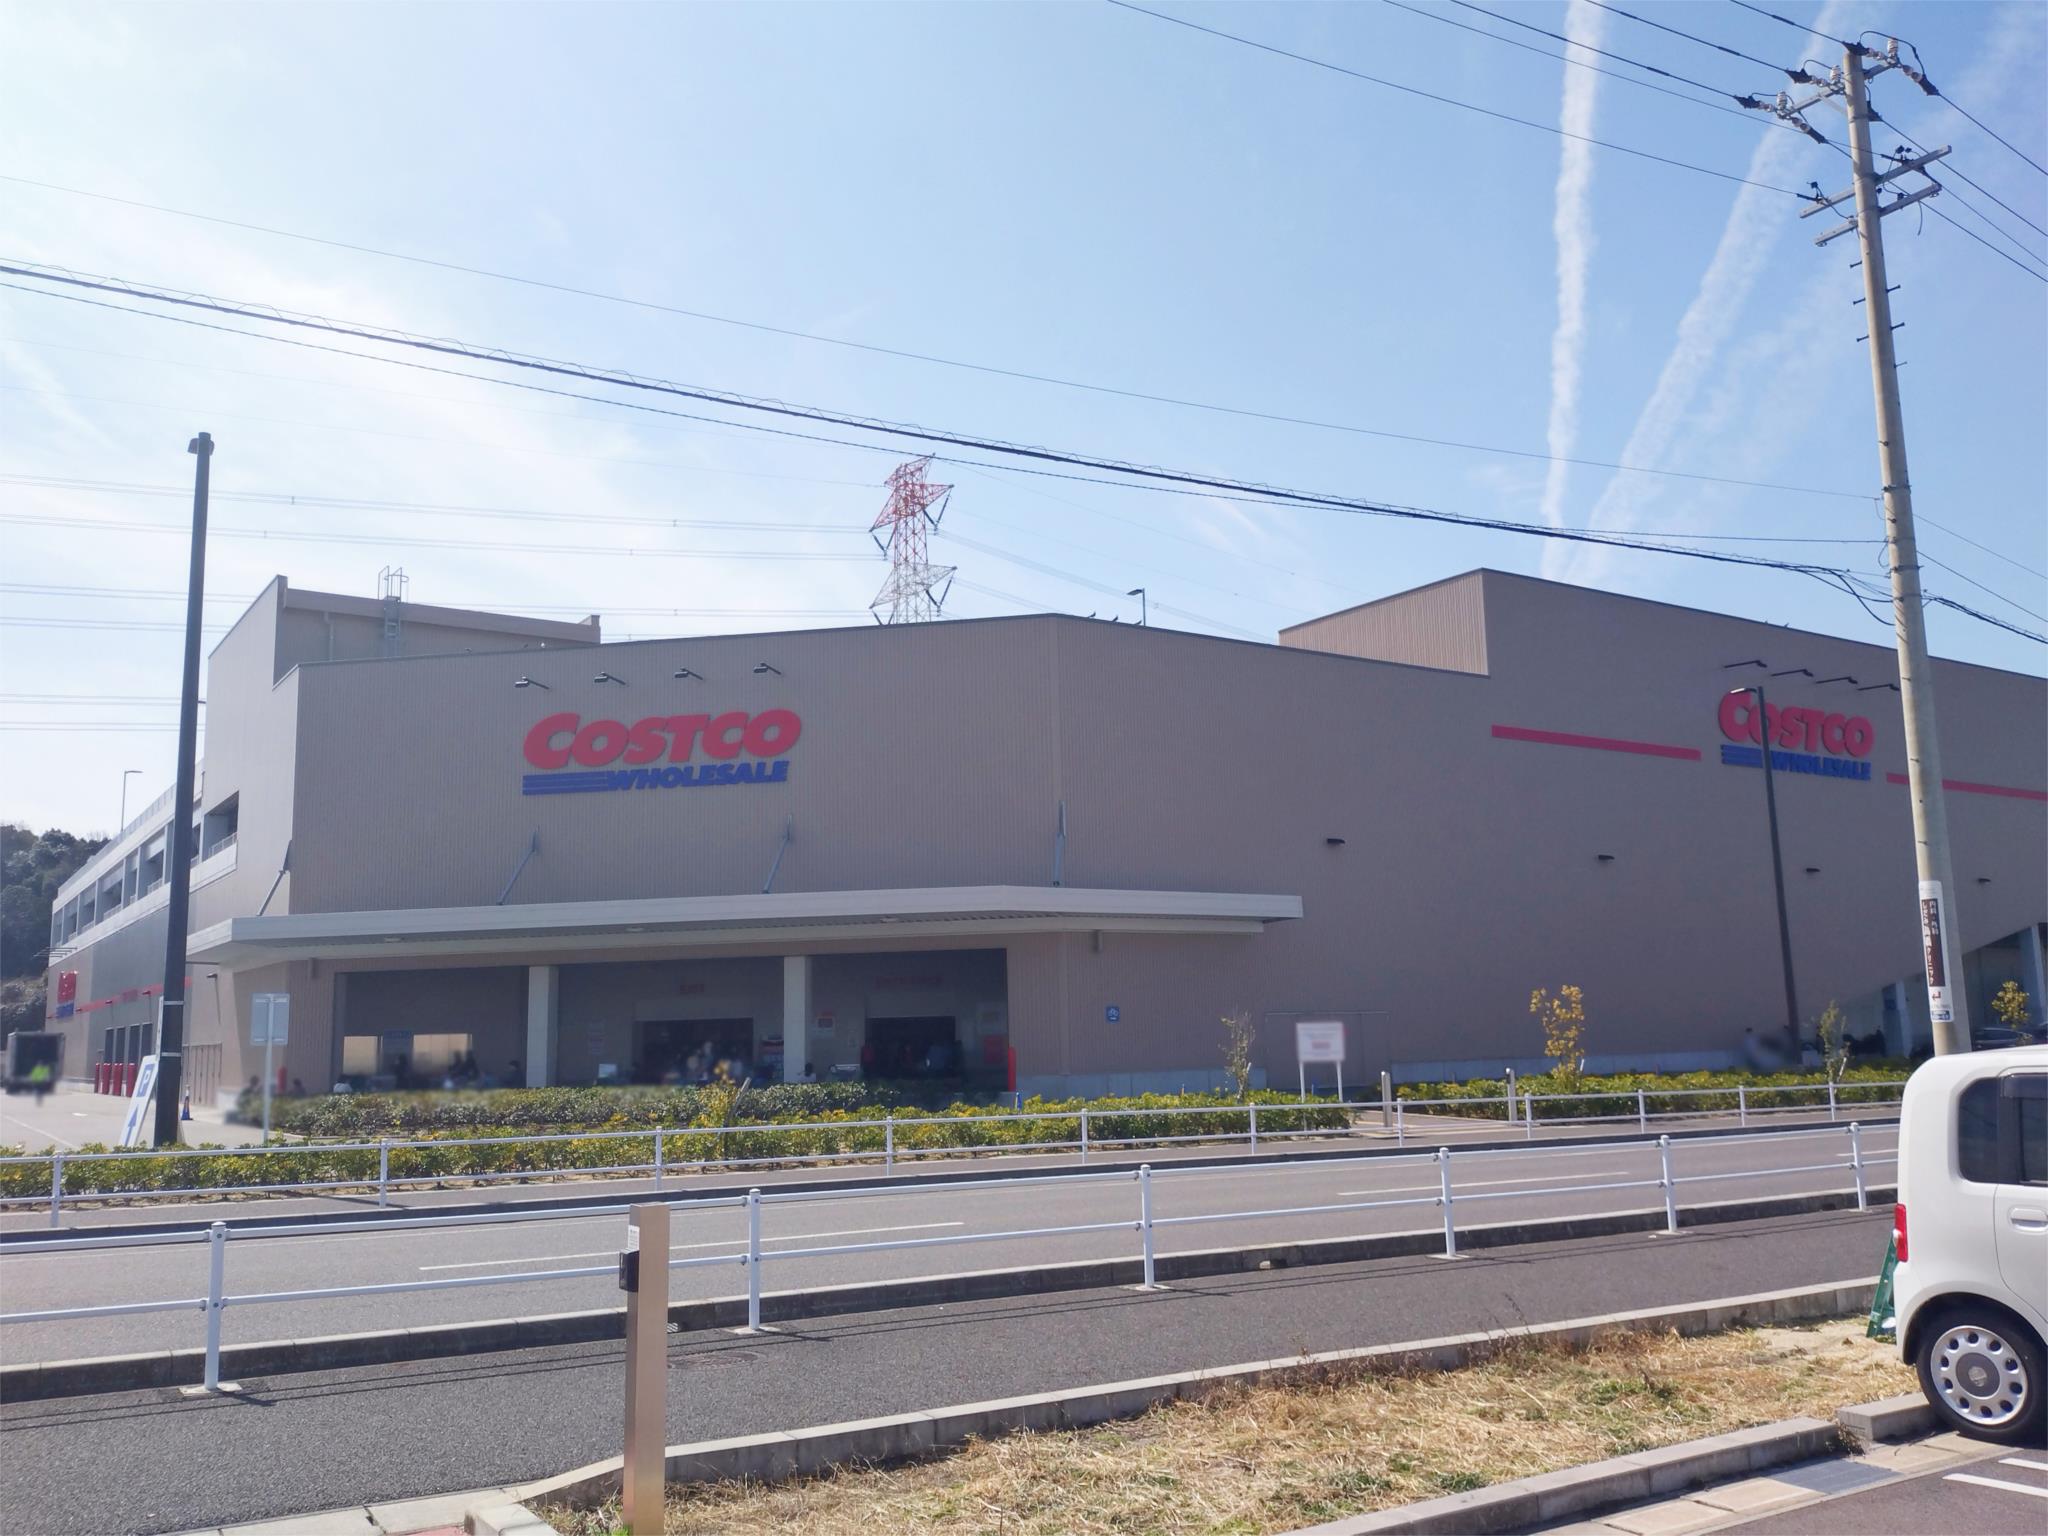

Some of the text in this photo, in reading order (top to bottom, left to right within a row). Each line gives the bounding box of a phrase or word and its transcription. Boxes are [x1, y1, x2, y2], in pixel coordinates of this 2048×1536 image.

[523, 708, 803, 769] COSTCO
[1718, 691, 1875, 758] COSTCO
[606, 760, 790, 791] WHOLESALE
[1769, 749, 1872, 782] WHOLESALE
[139, 1069, 151, 1094] P
